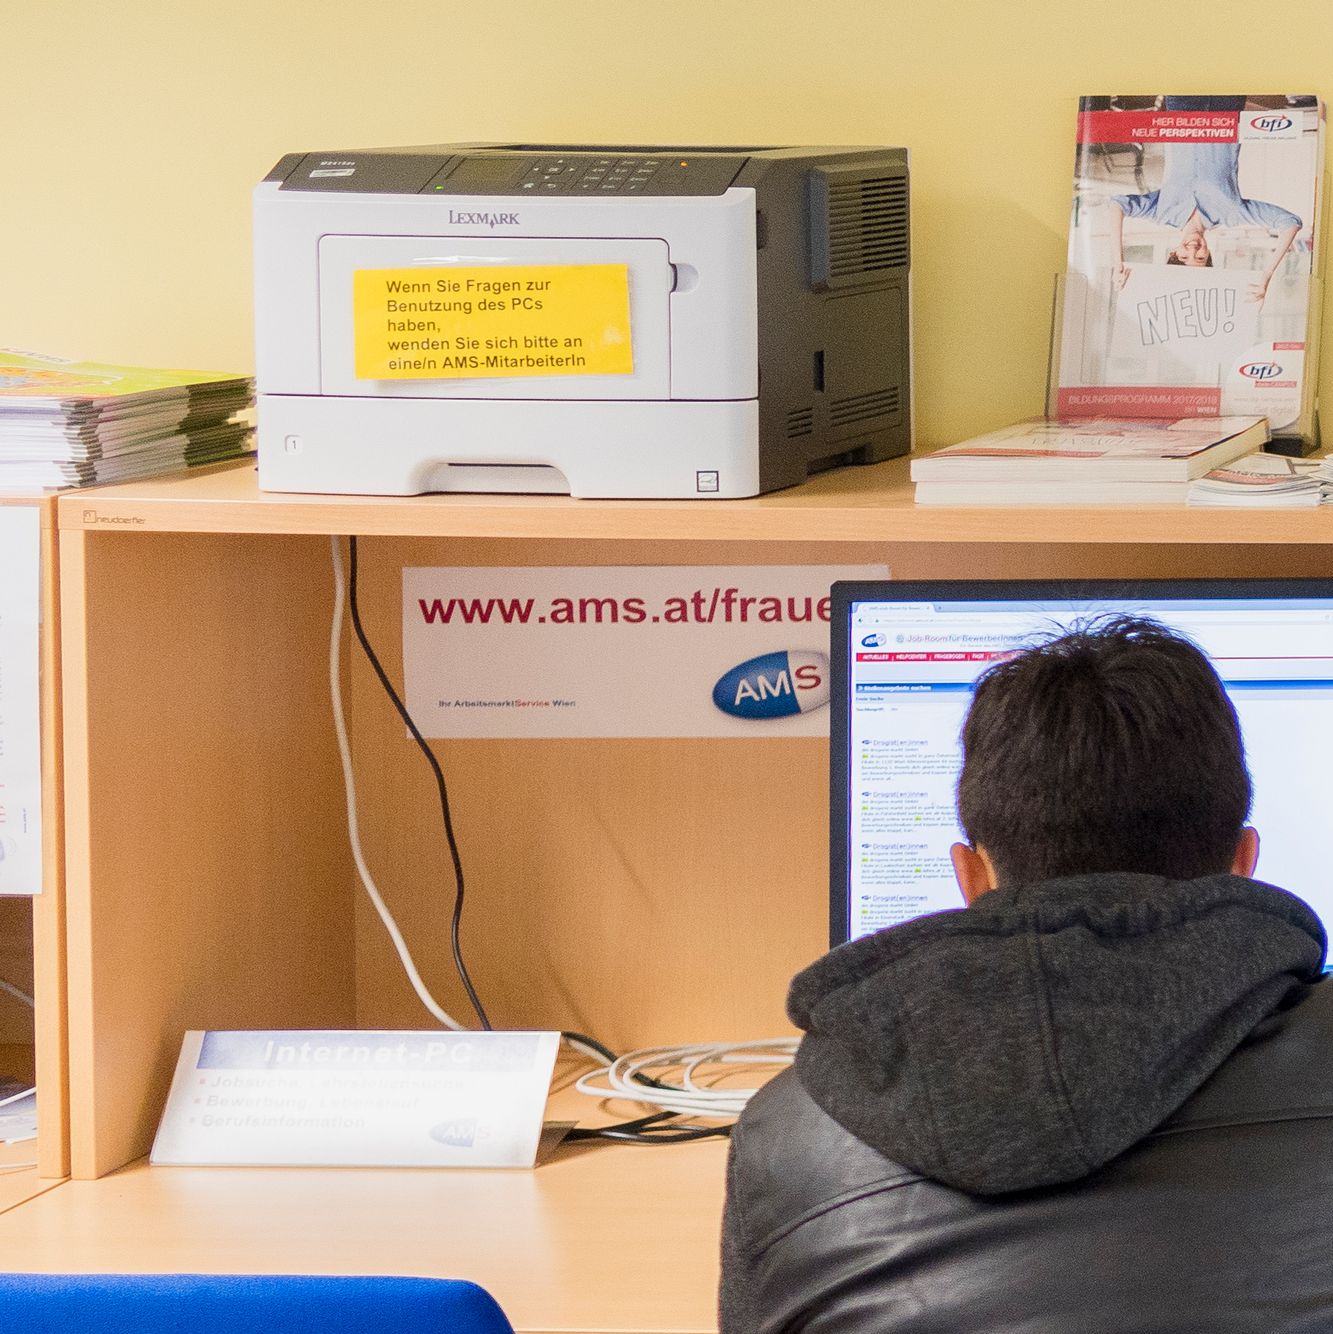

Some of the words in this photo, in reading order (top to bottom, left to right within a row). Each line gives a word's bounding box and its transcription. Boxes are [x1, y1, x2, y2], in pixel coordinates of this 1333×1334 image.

[1152, 118, 1175, 126] HIER
[1176, 118, 1210, 126] BILDEN
[1212, 118, 1235, 126] SICH
[1131, 128, 1156, 137] NEUE
[1160, 127, 1234, 137] PERSPEKTIVEN
[448, 210, 520, 229] LEXMARK
[385, 280, 431, 294] Wenn
[436, 279, 461, 293] Sie
[467, 279, 520, 295] Fragen
[525, 280, 552, 292] zur
[388, 299, 472, 315] Benutzung
[477, 297, 507, 312] des
[511, 296, 544, 311] PCs
[1137, 288, 1236, 346] NEU!
[388, 319, 440, 334] haben,
[387, 337, 450, 351] wenden
[455, 336, 480, 351] Sie
[485, 335, 519, 350] sich
[523, 335, 559, 349] bitte
[563, 337, 583, 348] an
[388, 356, 437, 370] eine/n
[443, 354, 585, 368] AMS-MitarbeiterIn
[734, 664, 822, 706] AMS
[263, 1039, 473, 1065] Internet-PC
[202, 1115, 366, 1129] Berufsinformation
[443, 1125, 490, 1140] AMS
